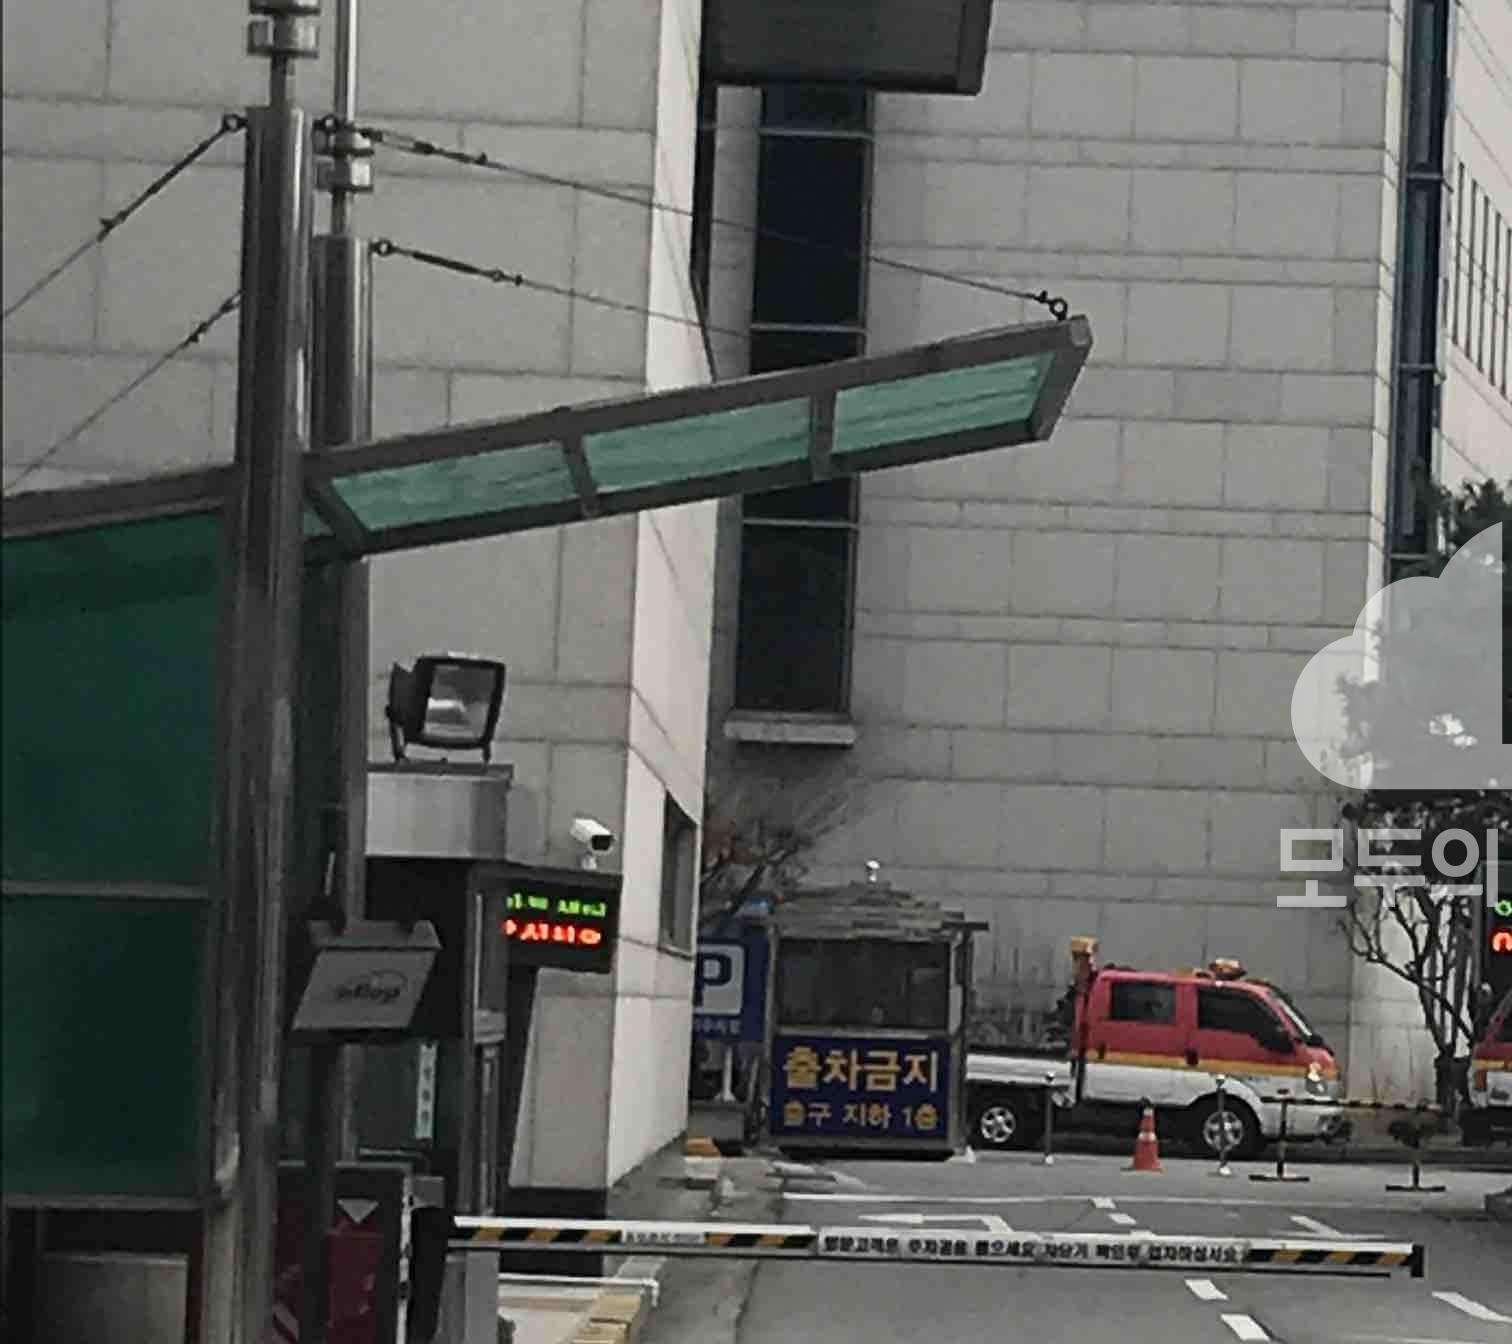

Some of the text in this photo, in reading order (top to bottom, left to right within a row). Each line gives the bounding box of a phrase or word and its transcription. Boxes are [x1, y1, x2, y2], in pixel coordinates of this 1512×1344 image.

[698, 953, 732, 1007] P
[784, 1046, 938, 1093] 출차금지
[784, 1101, 832, 1127] 출구
[843, 1103, 890, 1129] 지하
